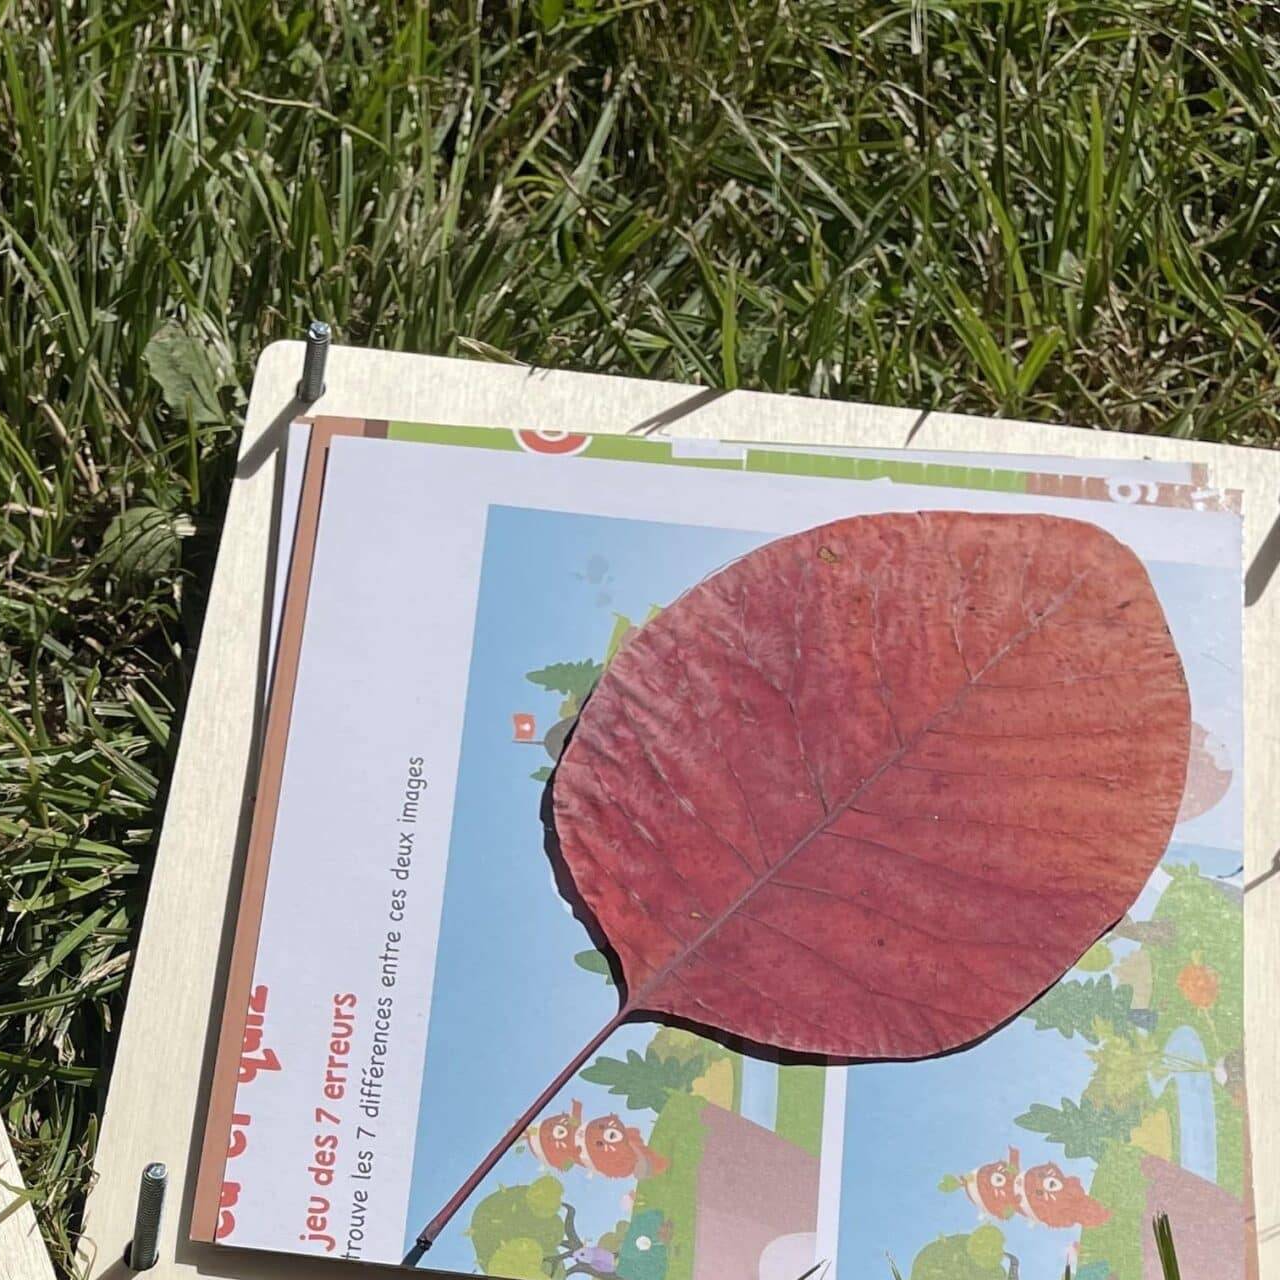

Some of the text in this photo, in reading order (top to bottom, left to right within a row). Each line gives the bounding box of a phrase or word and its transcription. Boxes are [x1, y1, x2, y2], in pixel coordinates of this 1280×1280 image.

[299, 992, 358, 1252] jeu des 7 erreurs
[340, 756, 428, 1260] trouve les 7 différences entre ces deux images
